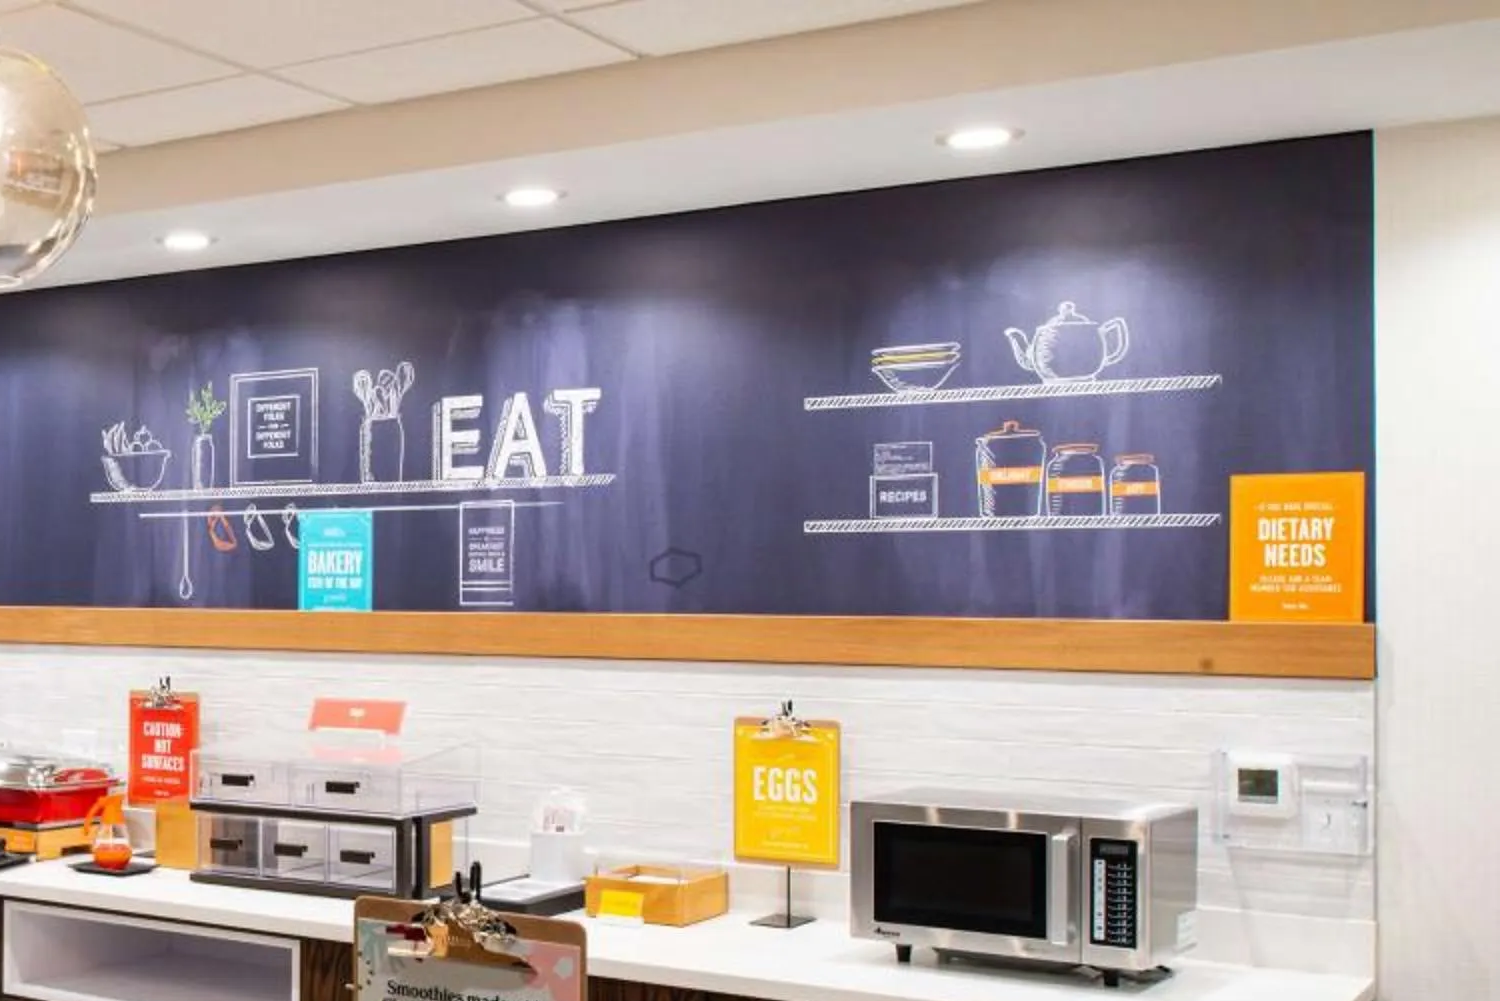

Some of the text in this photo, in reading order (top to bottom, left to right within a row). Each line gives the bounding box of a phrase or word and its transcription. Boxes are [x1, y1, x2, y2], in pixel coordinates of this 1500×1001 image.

[431, 387, 602, 481] EAT
[879, 490, 927, 503] RECIPES
[1257, 516, 1335, 541] DIETARY
[307, 549, 364, 575] BAKERY
[468, 558, 505, 573] SMILE
[1264, 543, 1327, 568] NEEDS
[143, 722, 181, 738] CAUTION
[154, 739, 172, 753] HOT
[141, 753, 185, 772] SURFACES
[753, 764, 819, 805] EGGS
